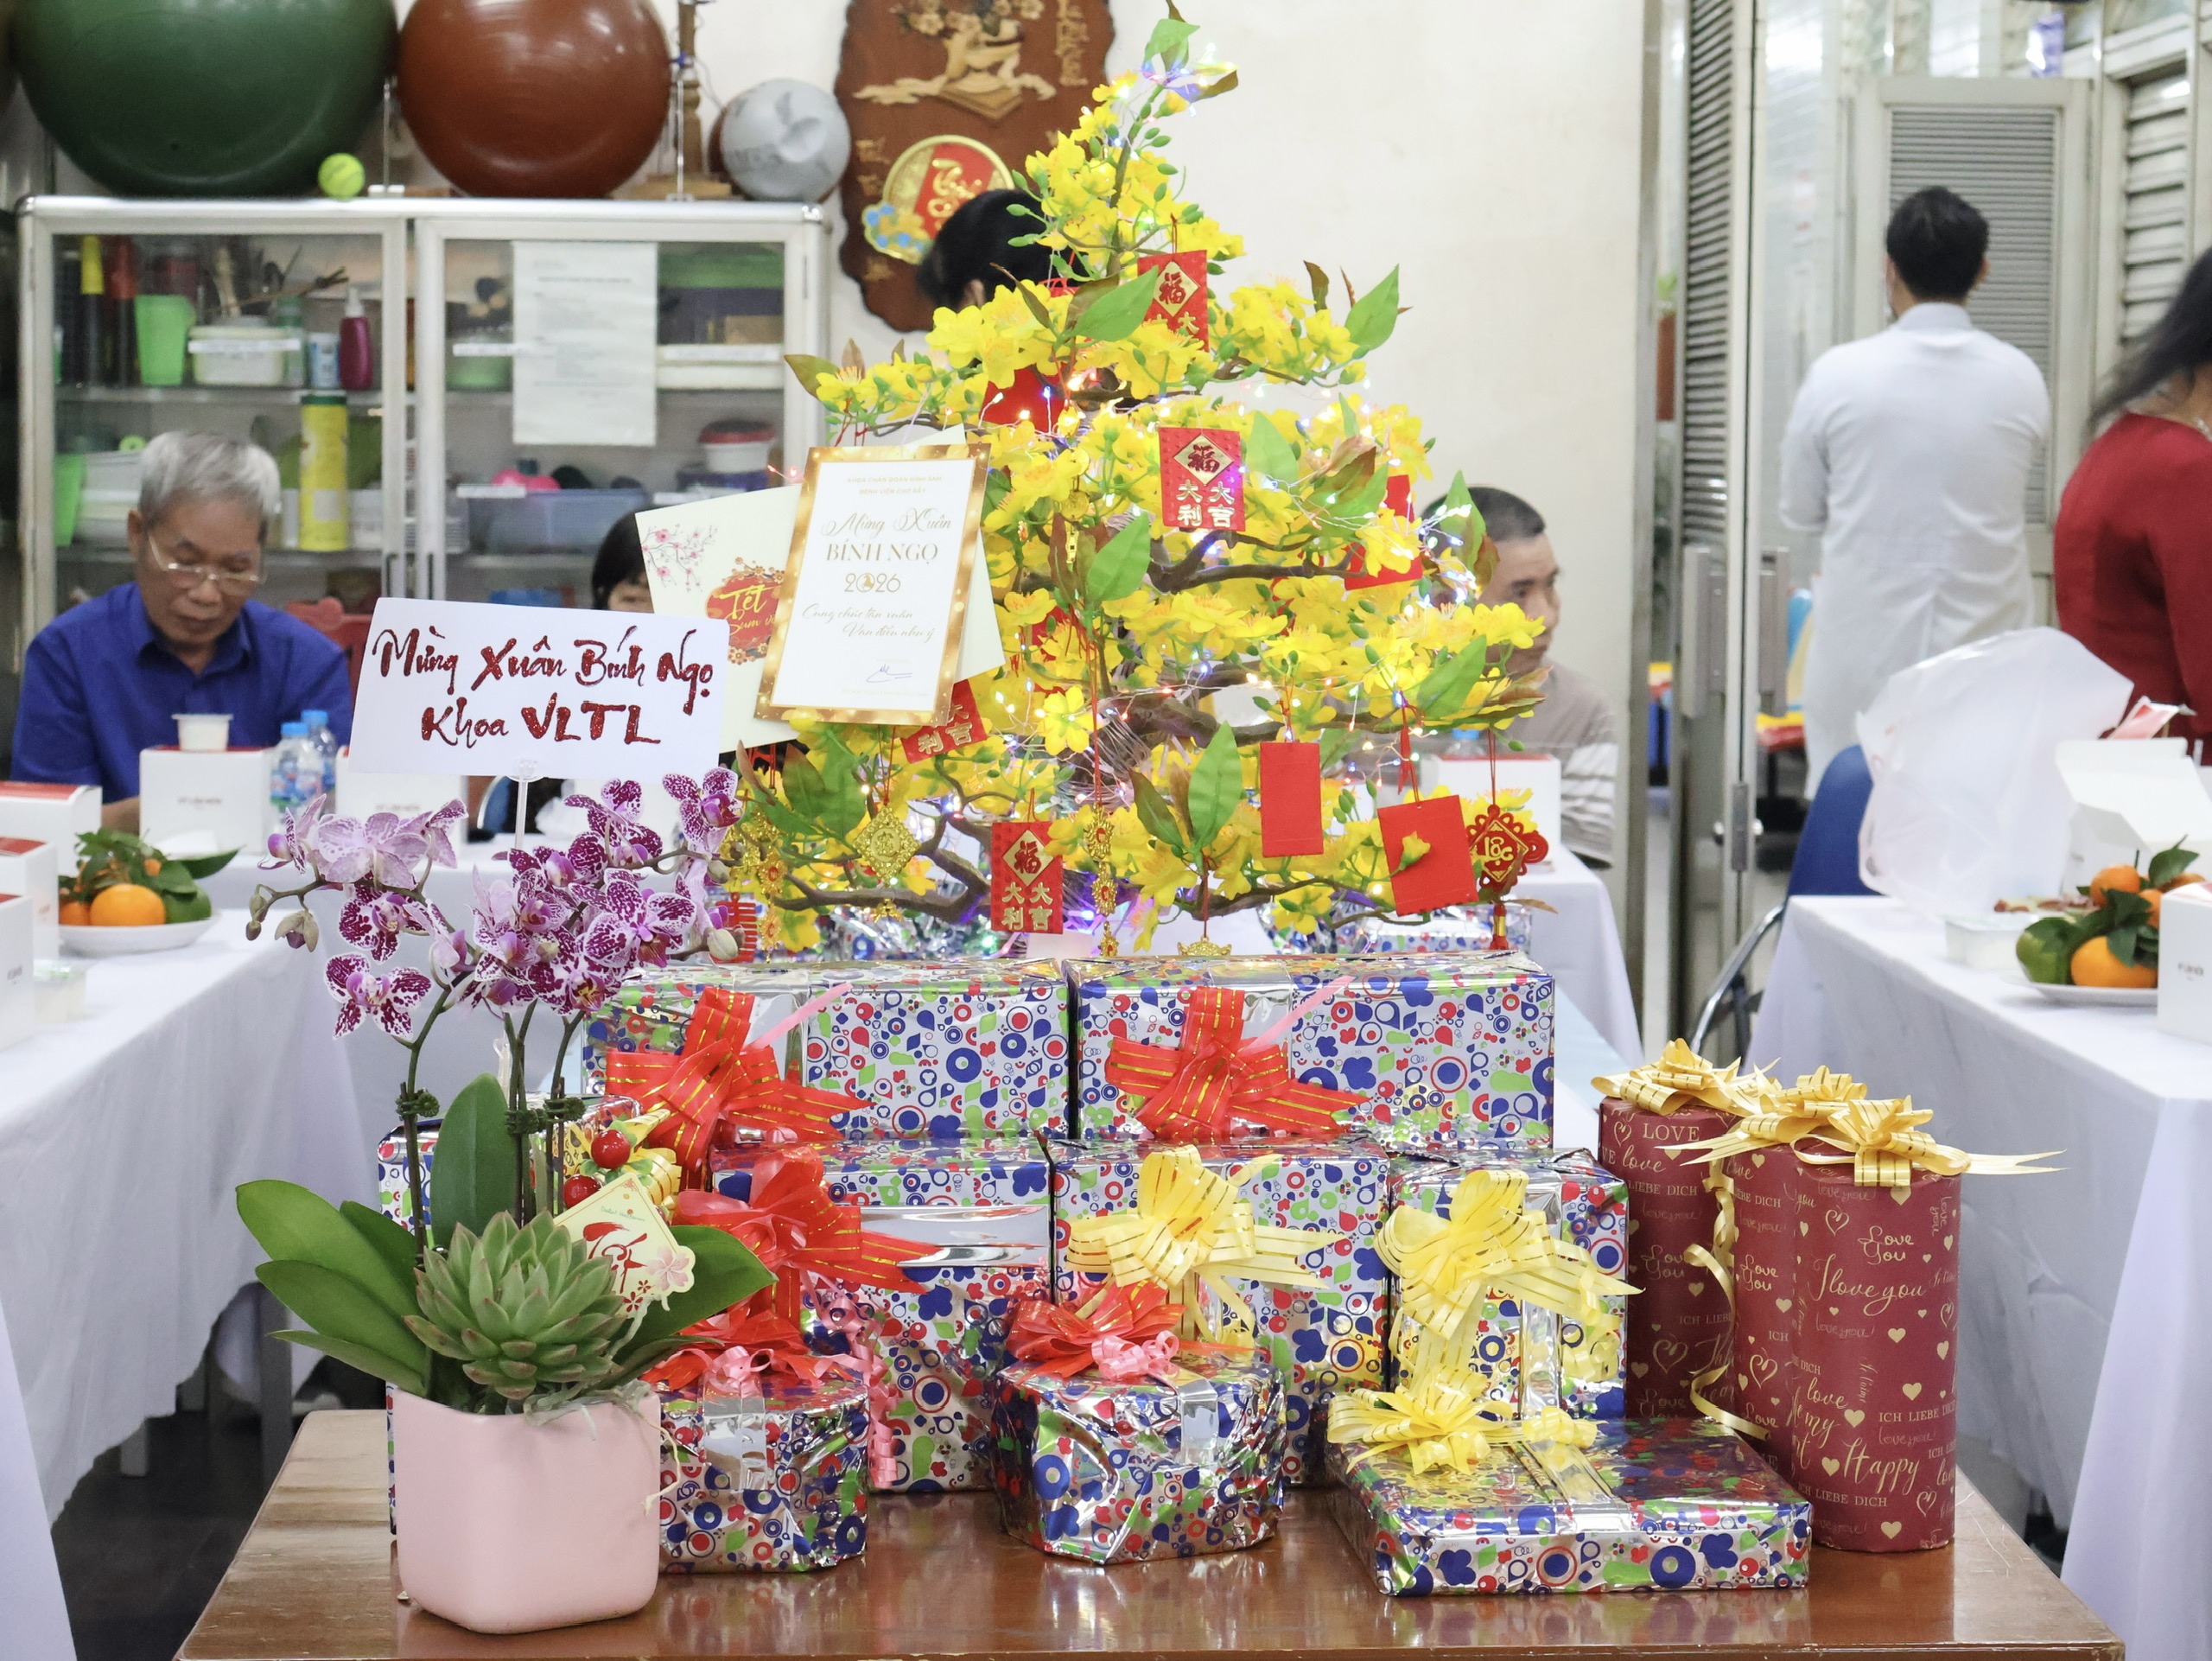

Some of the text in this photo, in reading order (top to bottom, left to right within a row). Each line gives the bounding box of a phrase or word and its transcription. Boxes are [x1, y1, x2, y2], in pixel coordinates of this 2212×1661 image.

[1159, 271, 1186, 304] 福
[1187, 444, 1221, 474] 福
[893, 507, 951, 532] Xuân
[826, 538, 938, 564] BÍNH NGỌ
[844, 573, 901, 593] 2026
[725, 609, 760, 635] Sum
[802, 603, 835, 624] Cung
[471, 635, 567, 690] Xuân
[574, 625, 644, 687] Bính
[657, 629, 714, 716] Ngọ
[422, 692, 661, 748] Khoa VLTL
[1014, 841, 1041, 875] 福
[1643, 1123, 1700, 1142] LOVE
[1623, 1144, 1667, 1173] love
[1628, 1180, 1698, 1197] LIEBE DICH
[1756, 1195, 1782, 1208] DICH
[1857, 1225, 1915, 1246] Love
[1641, 1244, 1684, 1264] Lov
[1863, 1242, 1906, 1265] You
[1645, 1259, 1685, 1280] You
[1740, 1255, 1779, 1278] Love
[1743, 1268, 1772, 1291] You
[1828, 1268, 1880, 1298] love
[1863, 1284, 1927, 1317] you
[1680, 1315, 1700, 1325] ICH
[1769, 1330, 1789, 1342] ICH
[1801, 1359, 1821, 1375] DICH
[1808, 1377, 1849, 1410] love
[1745, 1402, 1779, 1429] Love
[1879, 1412, 1902, 1422] ICH
[1909, 1409, 1938, 1422] LIEBE
[1805, 1411, 1840, 1448] my
[1928, 1448, 1943, 1460] ICH
[1842, 1437, 1920, 1497] Happy
[1815, 1488, 1849, 1505] LIEBE
[1854, 1496, 1888, 1507] DICH
